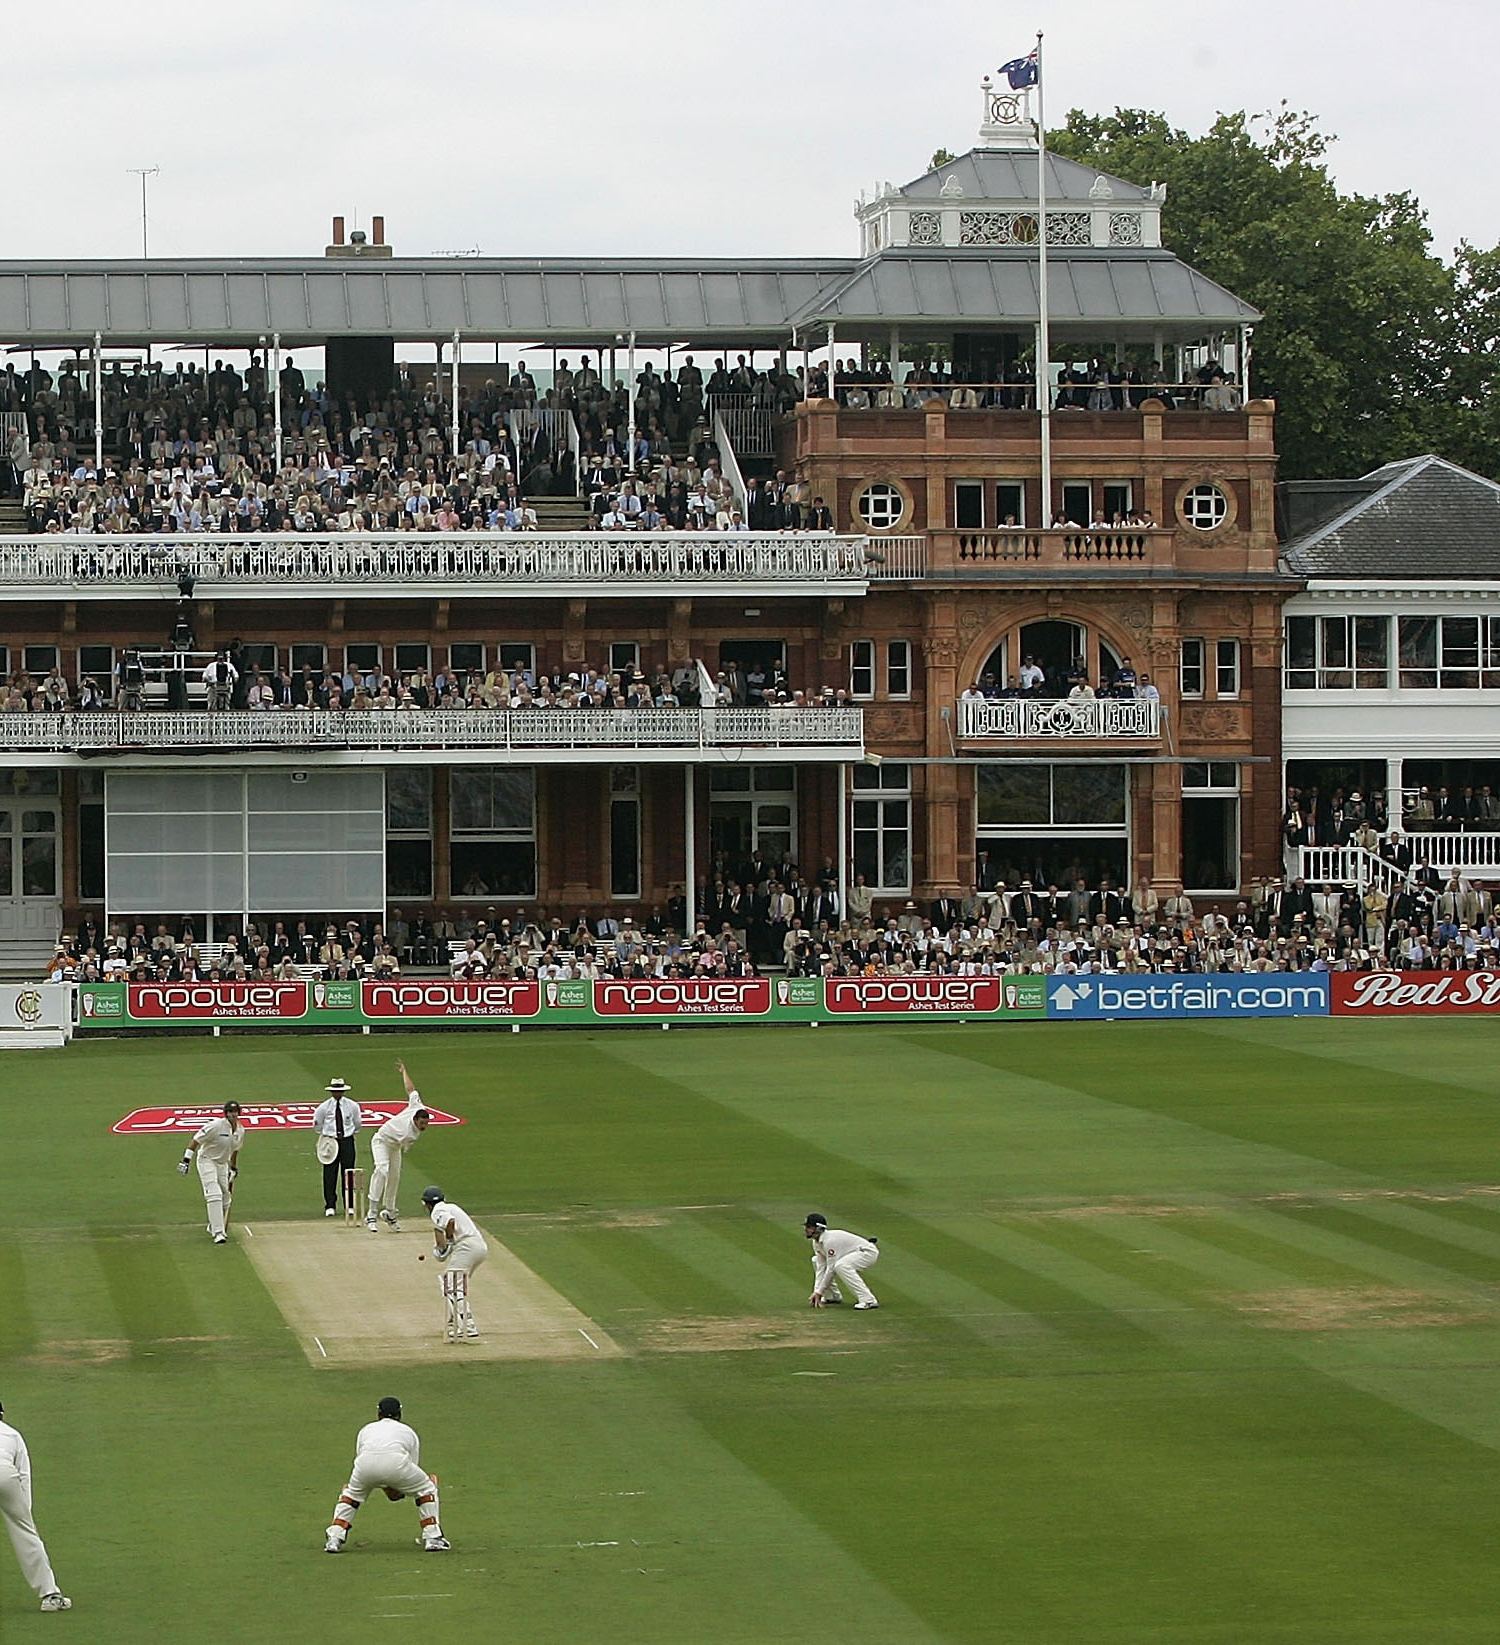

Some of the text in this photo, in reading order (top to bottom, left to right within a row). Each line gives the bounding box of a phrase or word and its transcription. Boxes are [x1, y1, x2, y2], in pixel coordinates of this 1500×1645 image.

[139, 987, 296, 1015] npower
[372, 986, 529, 1012] npower
[604, 984, 760, 1011] npower
[836, 981, 991, 1009] npower
[1098, 982, 1325, 1010] betfair.com
[1343, 973, 1453, 1007] Red
[212, 1007, 281, 1016] Ashes Test Series
[446, 1005, 514, 1014] Ashes Test Series
[677, 1003, 745, 1013] Ashes Test Series
[908, 1000, 975, 1010] Ashes Test Series
